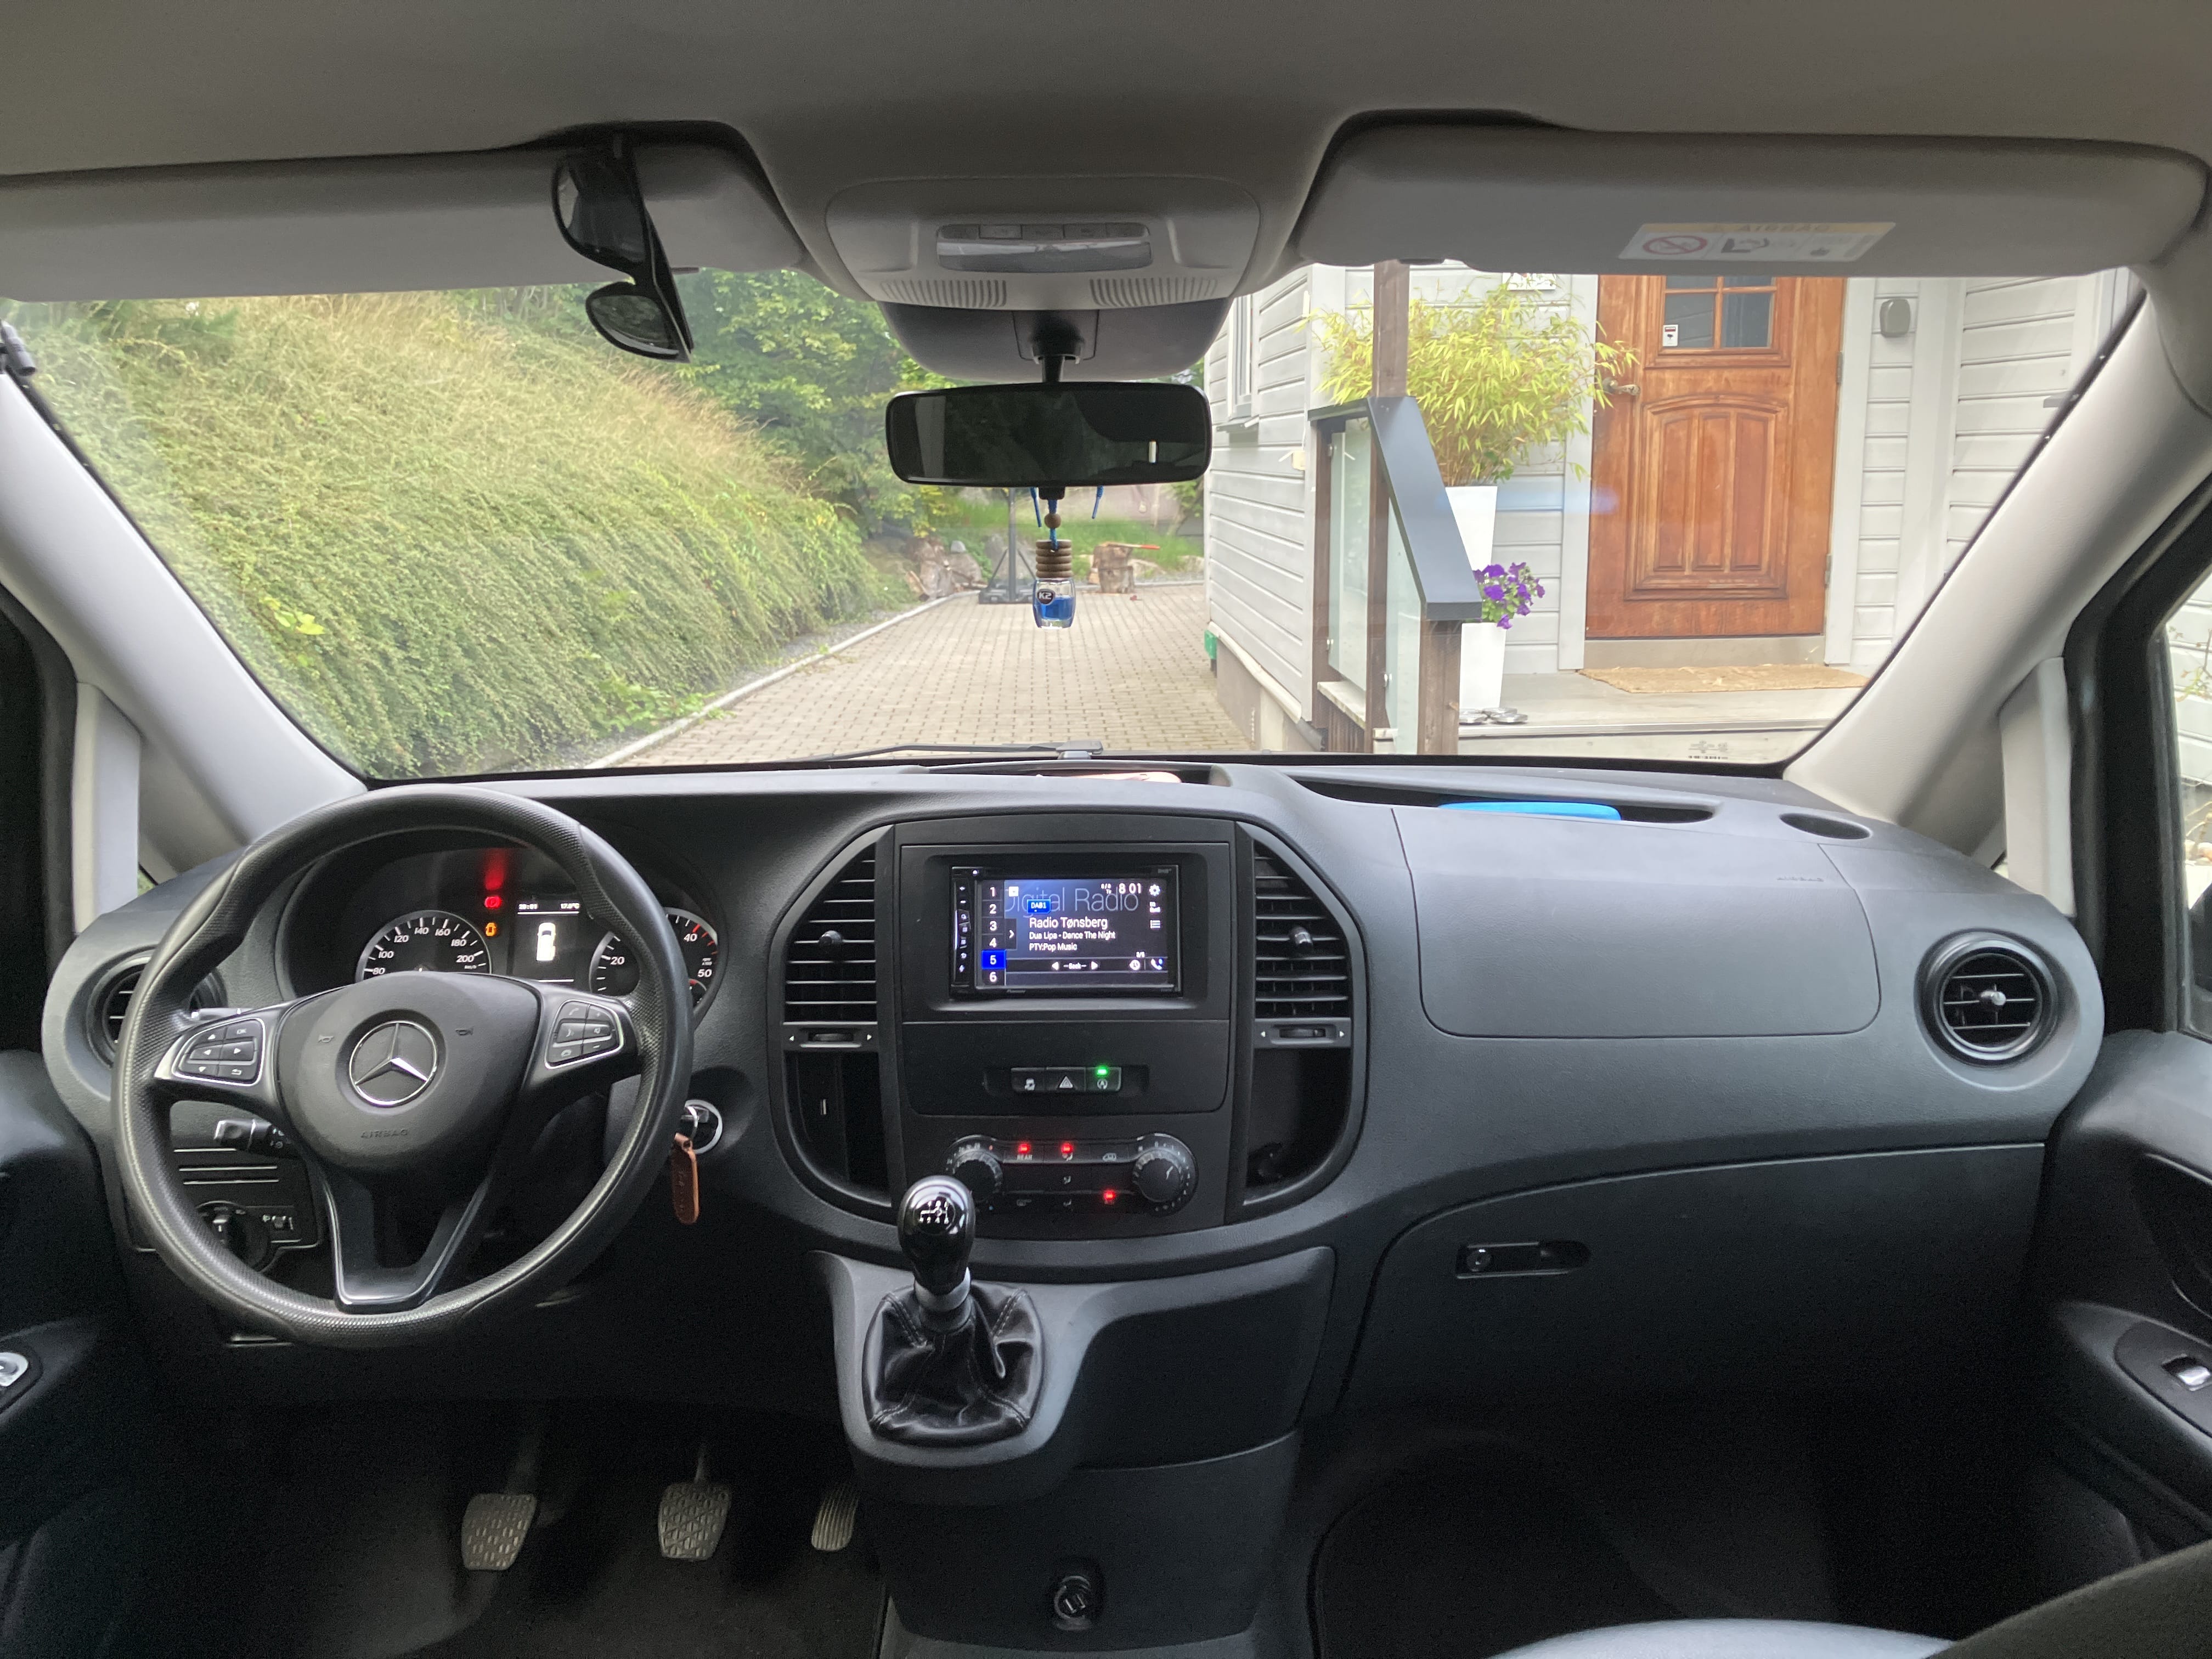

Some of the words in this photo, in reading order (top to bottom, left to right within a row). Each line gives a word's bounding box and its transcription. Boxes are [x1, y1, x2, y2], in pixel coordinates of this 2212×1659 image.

[990, 886, 996, 896] 1
[1075, 887, 1138, 912] Radio
[989, 904, 996, 913] 2
[989, 921, 997, 931] 3
[1029, 917, 1058, 928] Radio
[1060, 917, 1108, 930] Tønsberg
[394, 935, 409, 943] 120
[684, 933, 698, 942] 40
[1043, 932, 1057, 940] Lipa
[1098, 931, 1115, 940] Night
[451, 939, 467, 947] 180
[989, 938, 997, 947] 4
[1029, 943, 1056, 952] PTY:Pop
[1057, 943, 1077, 951] Music
[378, 951, 394, 959] 100
[456, 955, 475, 963] 200
[610, 956, 625, 965] 20
[990, 955, 996, 965] 5
[697, 969, 712, 978] 50
[989, 972, 997, 982] 6
[360, 1128, 408, 1138] AIRBAG
